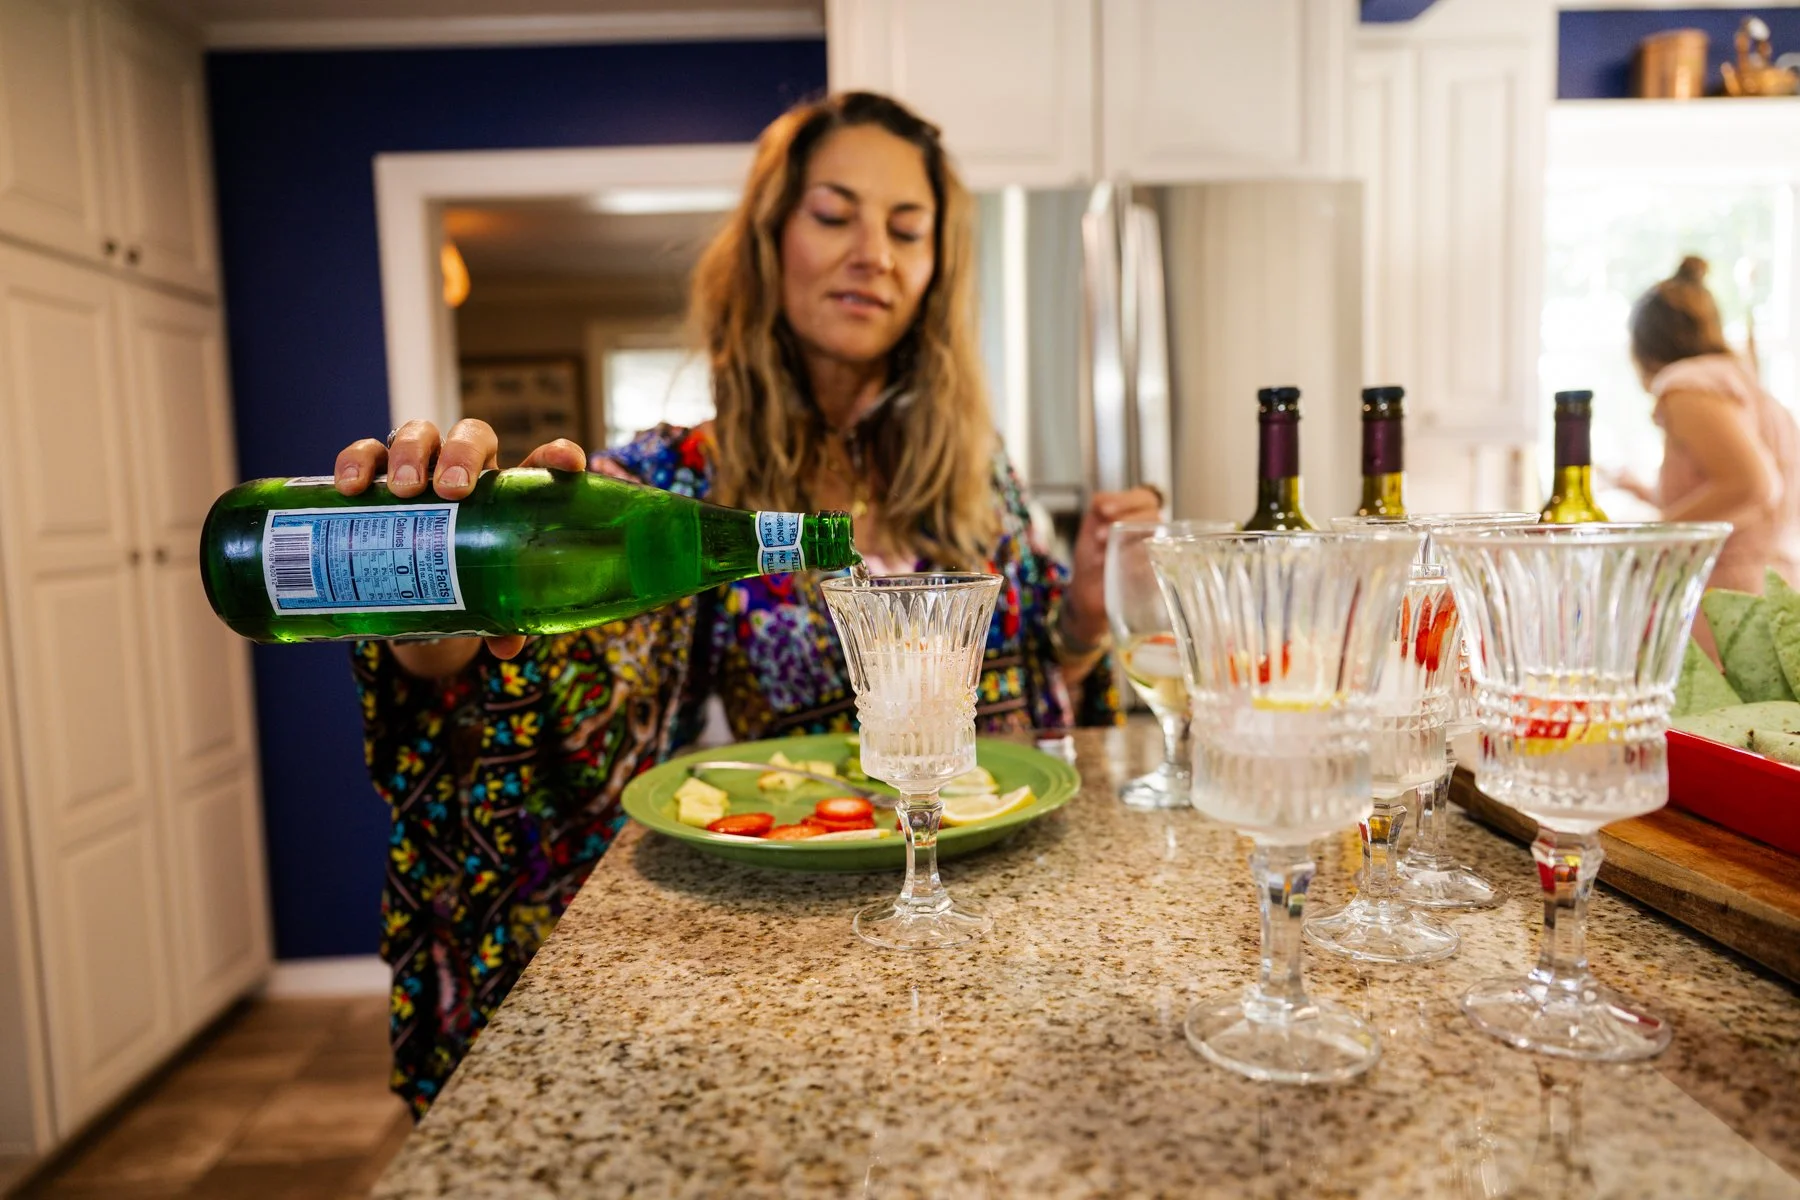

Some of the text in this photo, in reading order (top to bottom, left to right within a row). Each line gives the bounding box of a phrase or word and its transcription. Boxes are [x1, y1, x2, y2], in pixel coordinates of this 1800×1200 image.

[396, 518, 407, 547] Calories
[417, 517, 426, 537] Serving
[426, 517, 434, 531] About
[434, 517, 450, 597] Nutrition Facts
[396, 566, 409, 574] 0
